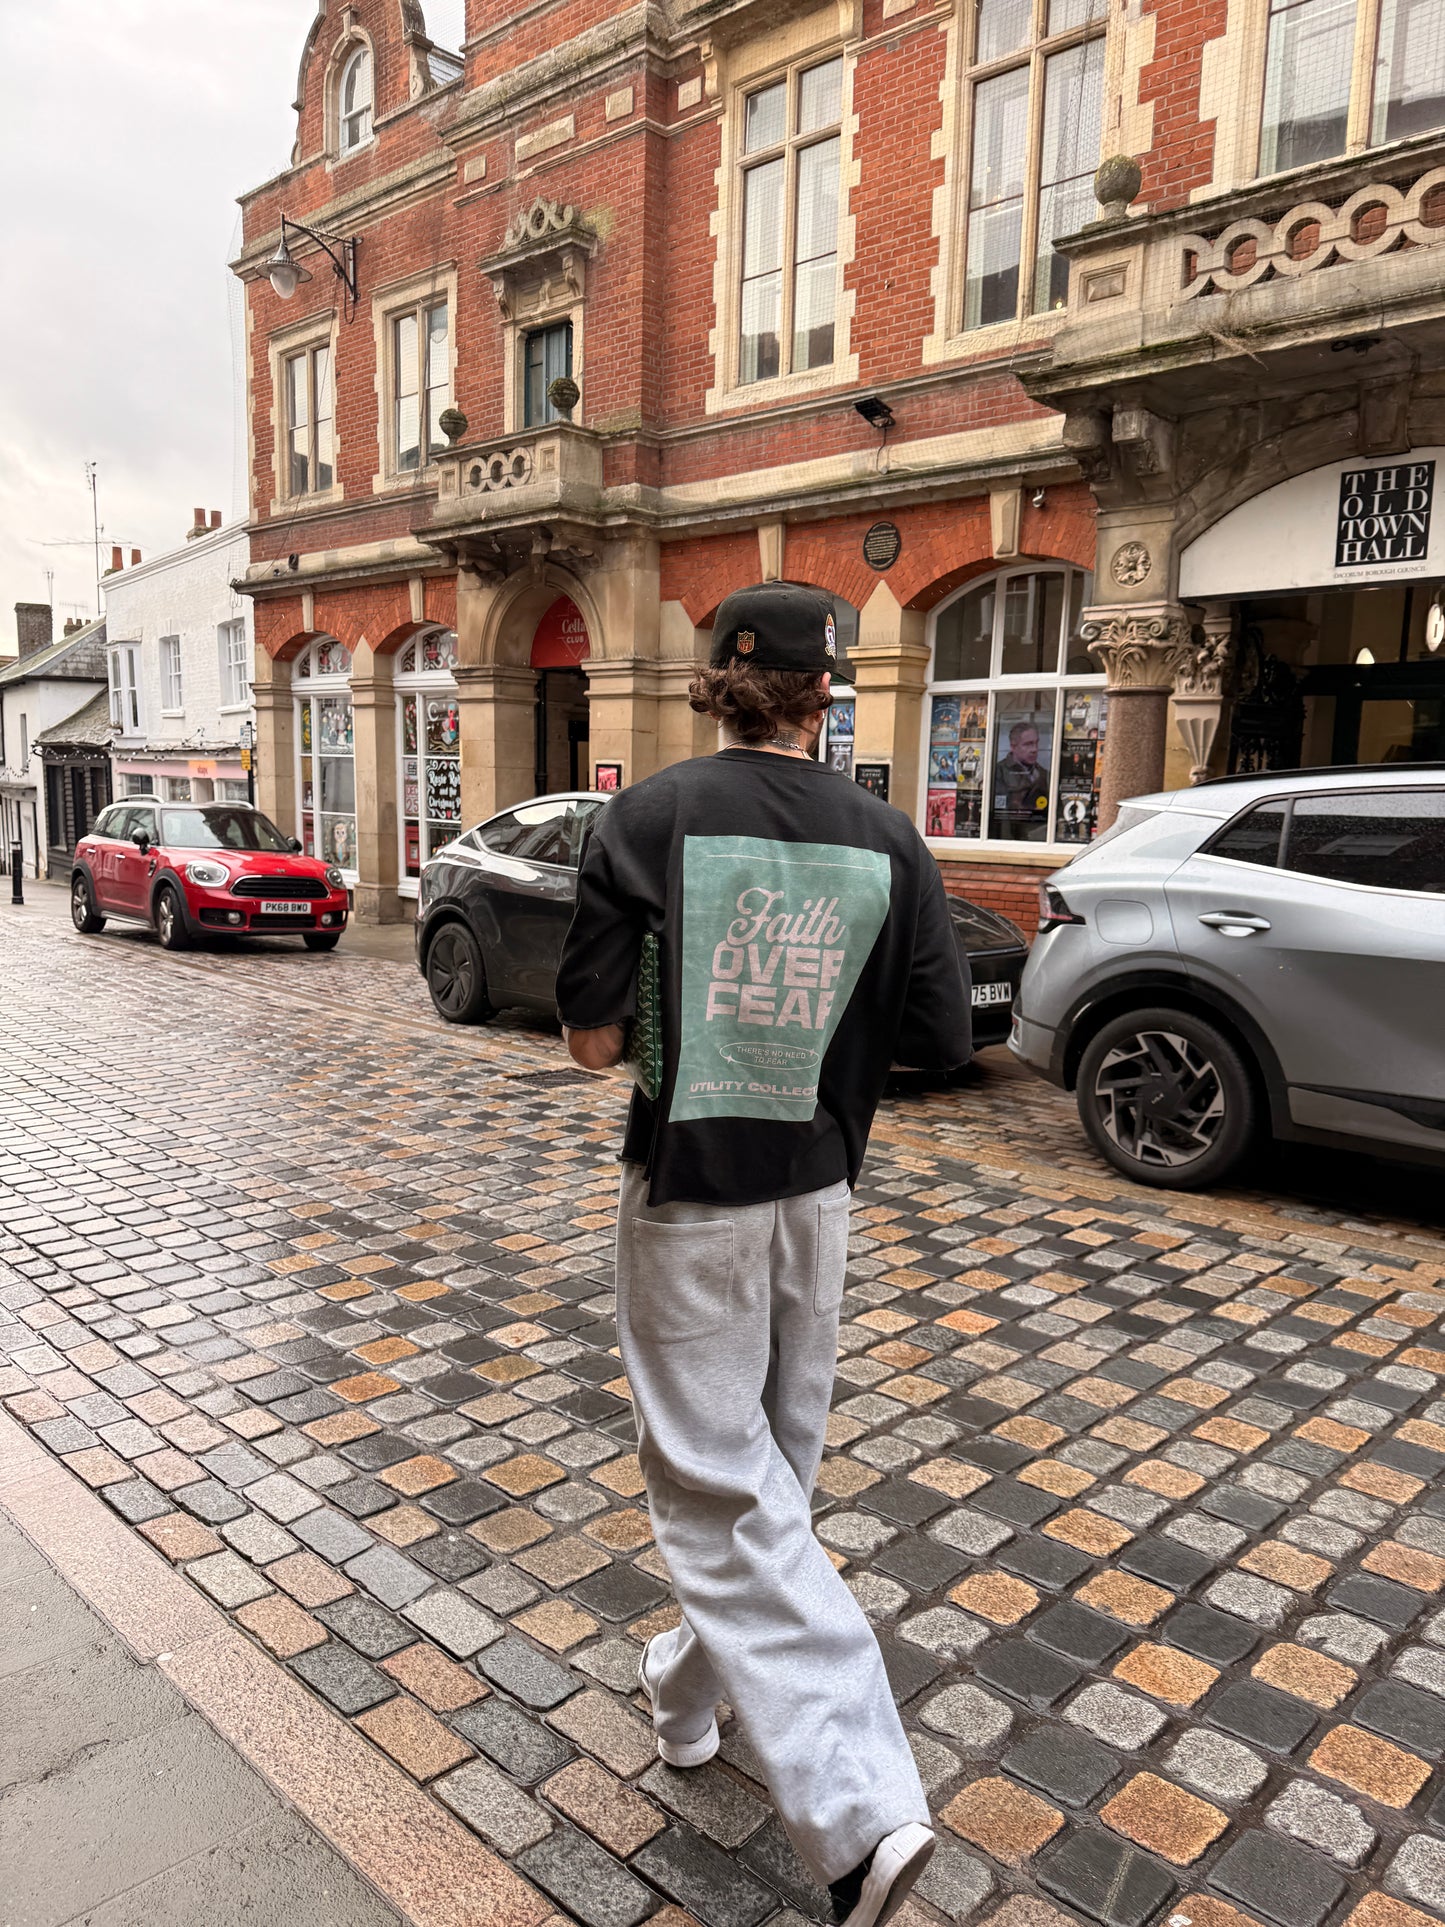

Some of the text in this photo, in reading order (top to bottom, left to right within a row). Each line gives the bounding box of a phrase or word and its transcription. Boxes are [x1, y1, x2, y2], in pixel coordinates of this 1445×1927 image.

[1345, 465, 1429, 495] THE
[1343, 489, 1428, 518] OLD
[1341, 511, 1430, 541] TOWN
[1339, 535, 1425, 563] HALL
[566, 635, 584, 643] CLUB
[727, 887, 846, 946] Faith
[737, 1046, 770, 1056] THERE'S
[785, 1051, 806, 1059] NEED
[766, 1057, 788, 1065] FEAR
[690, 1081, 744, 1093] UTILITY
